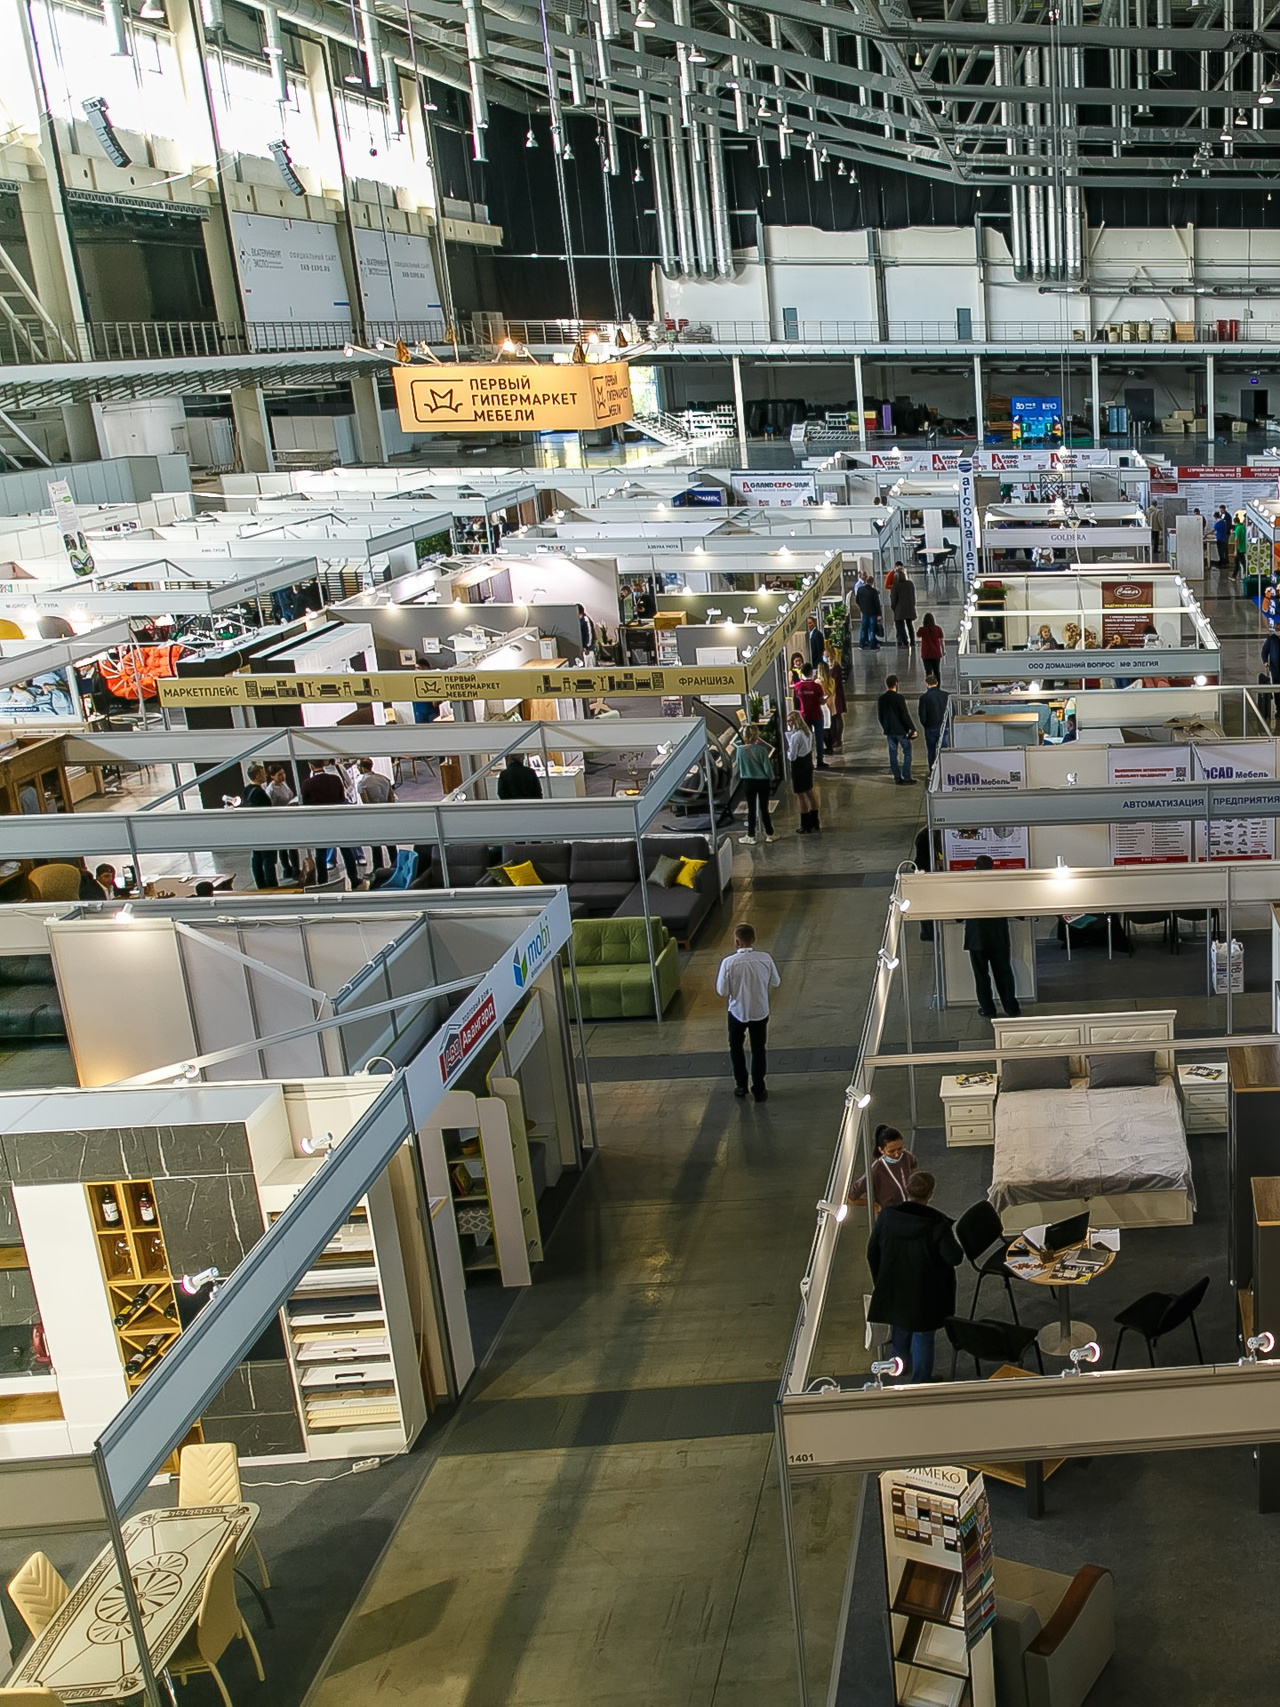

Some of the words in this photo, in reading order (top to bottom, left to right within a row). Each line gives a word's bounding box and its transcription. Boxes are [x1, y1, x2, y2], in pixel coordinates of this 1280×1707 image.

[469, 375, 531, 391] ПЕРВЫЙ
[604, 371, 618, 387] ПЕРВЫЙ
[471, 393, 578, 407] ГИПЕРМАРКЕТ
[473, 409, 535, 422] МЕБЕЛИ
[1028, 662, 1044, 670] ООО
[1044, 660, 1086, 671] ДОМАШНИЙ
[1086, 661, 1115, 669] ВОПРОС
[1119, 660, 1132, 669] МФ
[1132, 660, 1159, 668] ЭЛЕГИЯ
[443, 674, 477, 684] ПЕРВЫЙ
[677, 674, 736, 688] ФРАНШИЗА
[163, 685, 239, 698] МАРКЕТПЛЕЙС
[444, 681, 501, 692] ГИПЕРМАРКЕТ
[445, 690, 480, 699] МЕБЕЛИ
[947, 773, 980, 786] bCAD
[980, 778, 1011, 786] Мебель
[1204, 766, 1234, 780] bCAD
[1235, 770, 1269, 779] Мебель
[1122, 798, 1204, 809] АВТОМАТИЗАЦИЯ
[1212, 795, 1280, 806] ПРЕДПРИЯТИЯ
[527, 915, 551, 967] mobi
[462, 1002, 495, 1049] Авангард
[789, 1453, 814, 1463] 1401
